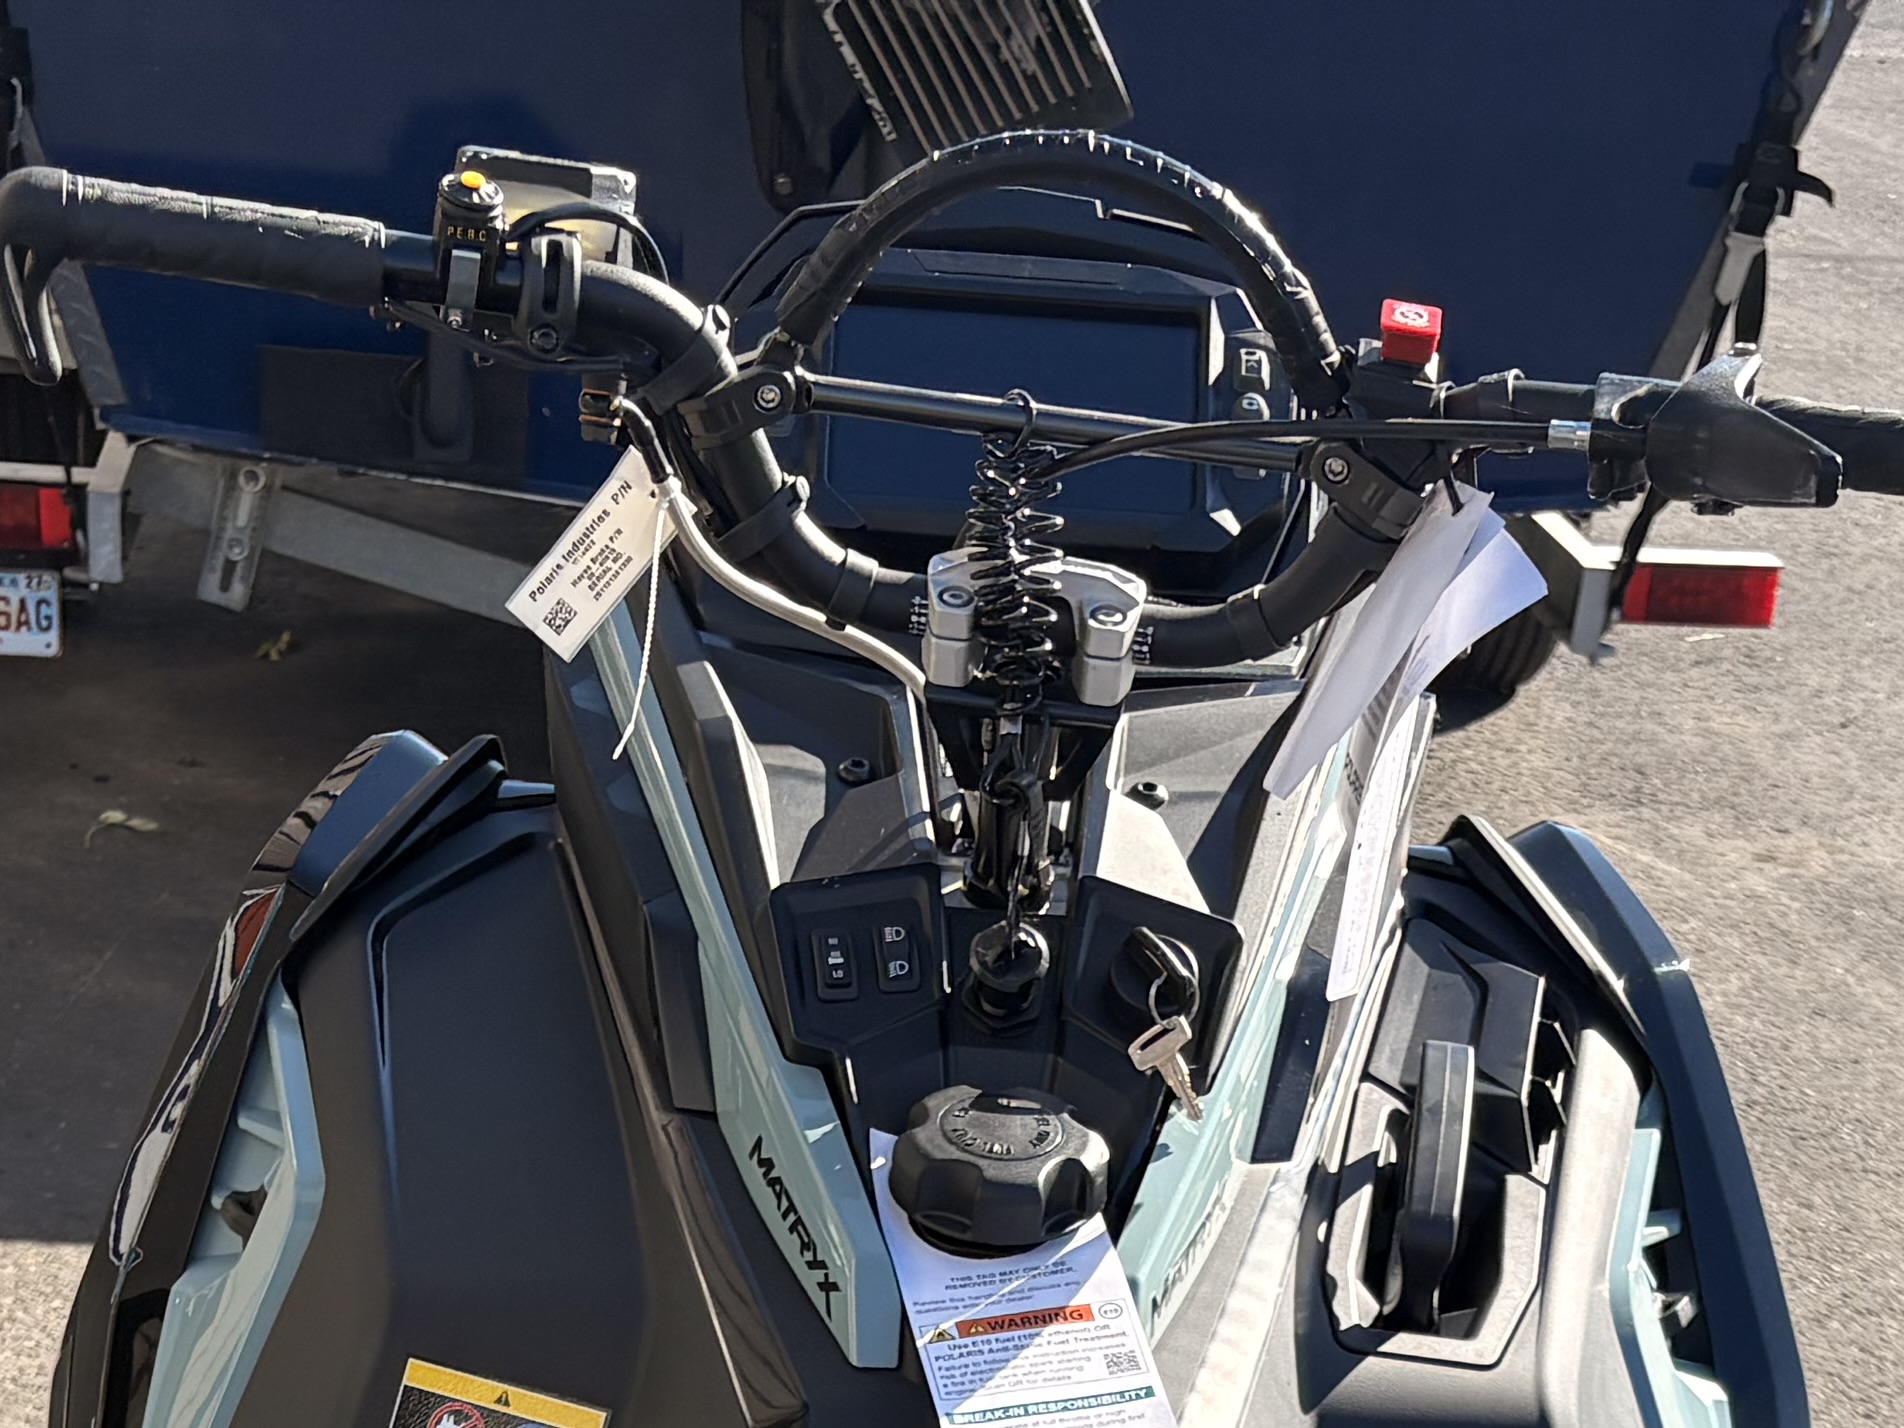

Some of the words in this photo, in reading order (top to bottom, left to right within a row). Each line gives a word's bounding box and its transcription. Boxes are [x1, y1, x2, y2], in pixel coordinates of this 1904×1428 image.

[560, 507, 611, 563] Industries
[609, 480, 633, 505] P/N
[748, 1135, 842, 1322] MATRYX
[944, 1278, 996, 1291] REMOVED
[987, 1306, 1083, 1333] WARNING
[934, 1348, 985, 1363] POLARIS
[947, 1342, 968, 1351] Use
[995, 1334, 1016, 1345] fuel
[953, 1406, 1024, 1424] BREAK-IN
[1028, 1389, 1147, 1414] RESPONSIBILITY
